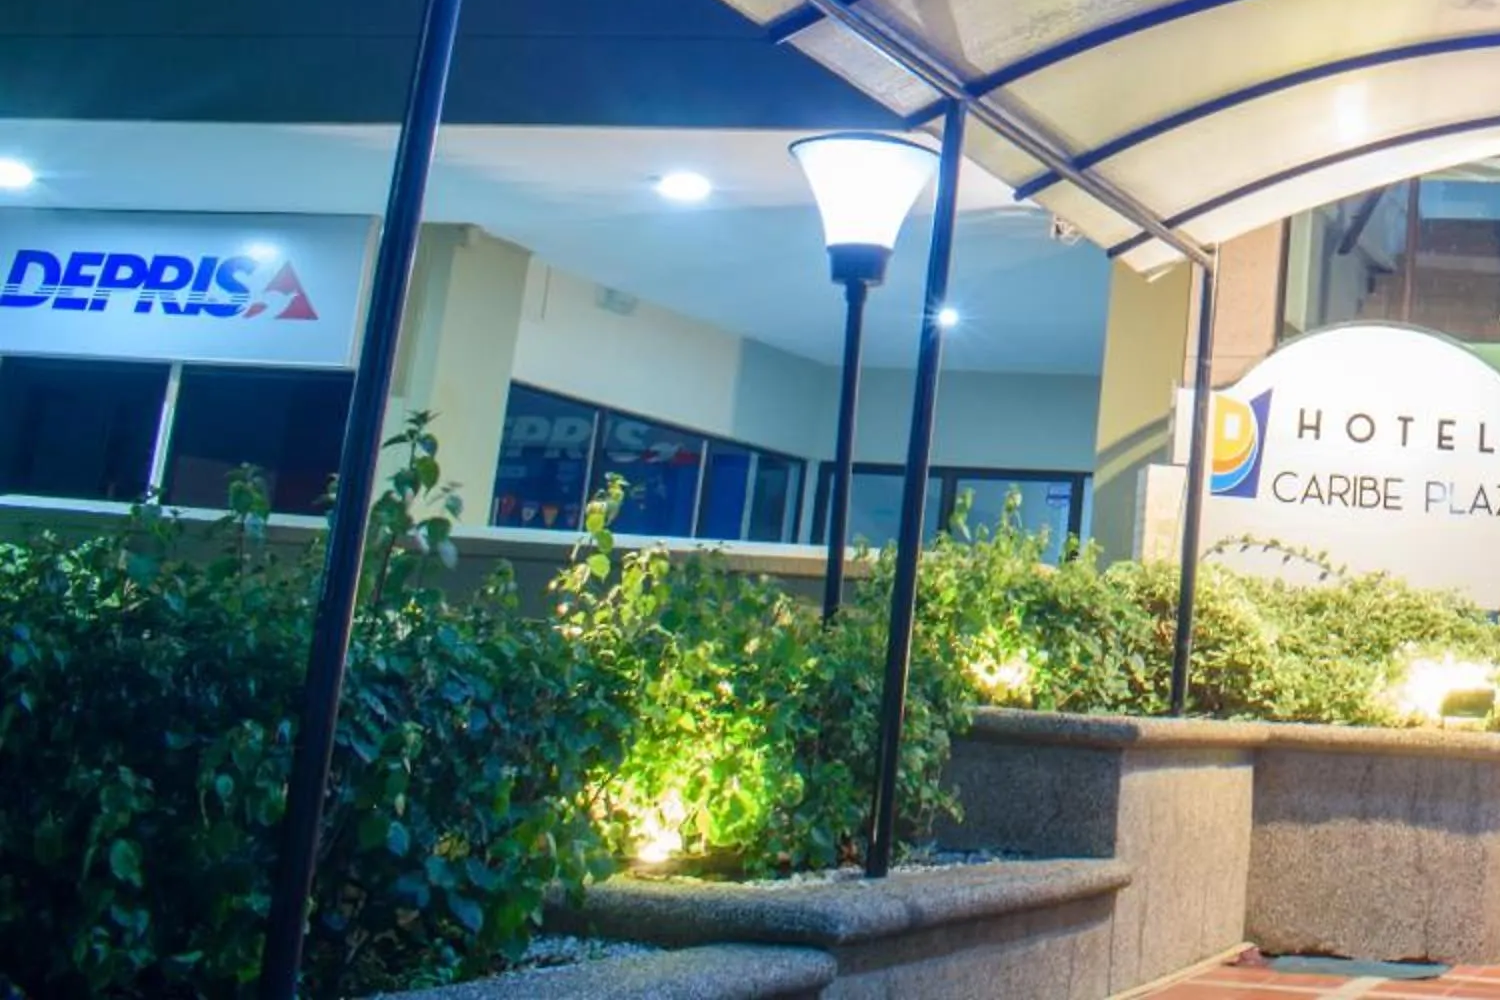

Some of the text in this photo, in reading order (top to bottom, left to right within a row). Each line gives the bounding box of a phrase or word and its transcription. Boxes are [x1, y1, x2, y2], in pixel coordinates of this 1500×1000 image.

[0, 249, 319, 321] DEPRISA
[1298, 407, 1495, 453] HOTEL
[1272, 471, 1404, 511] CARIBE
